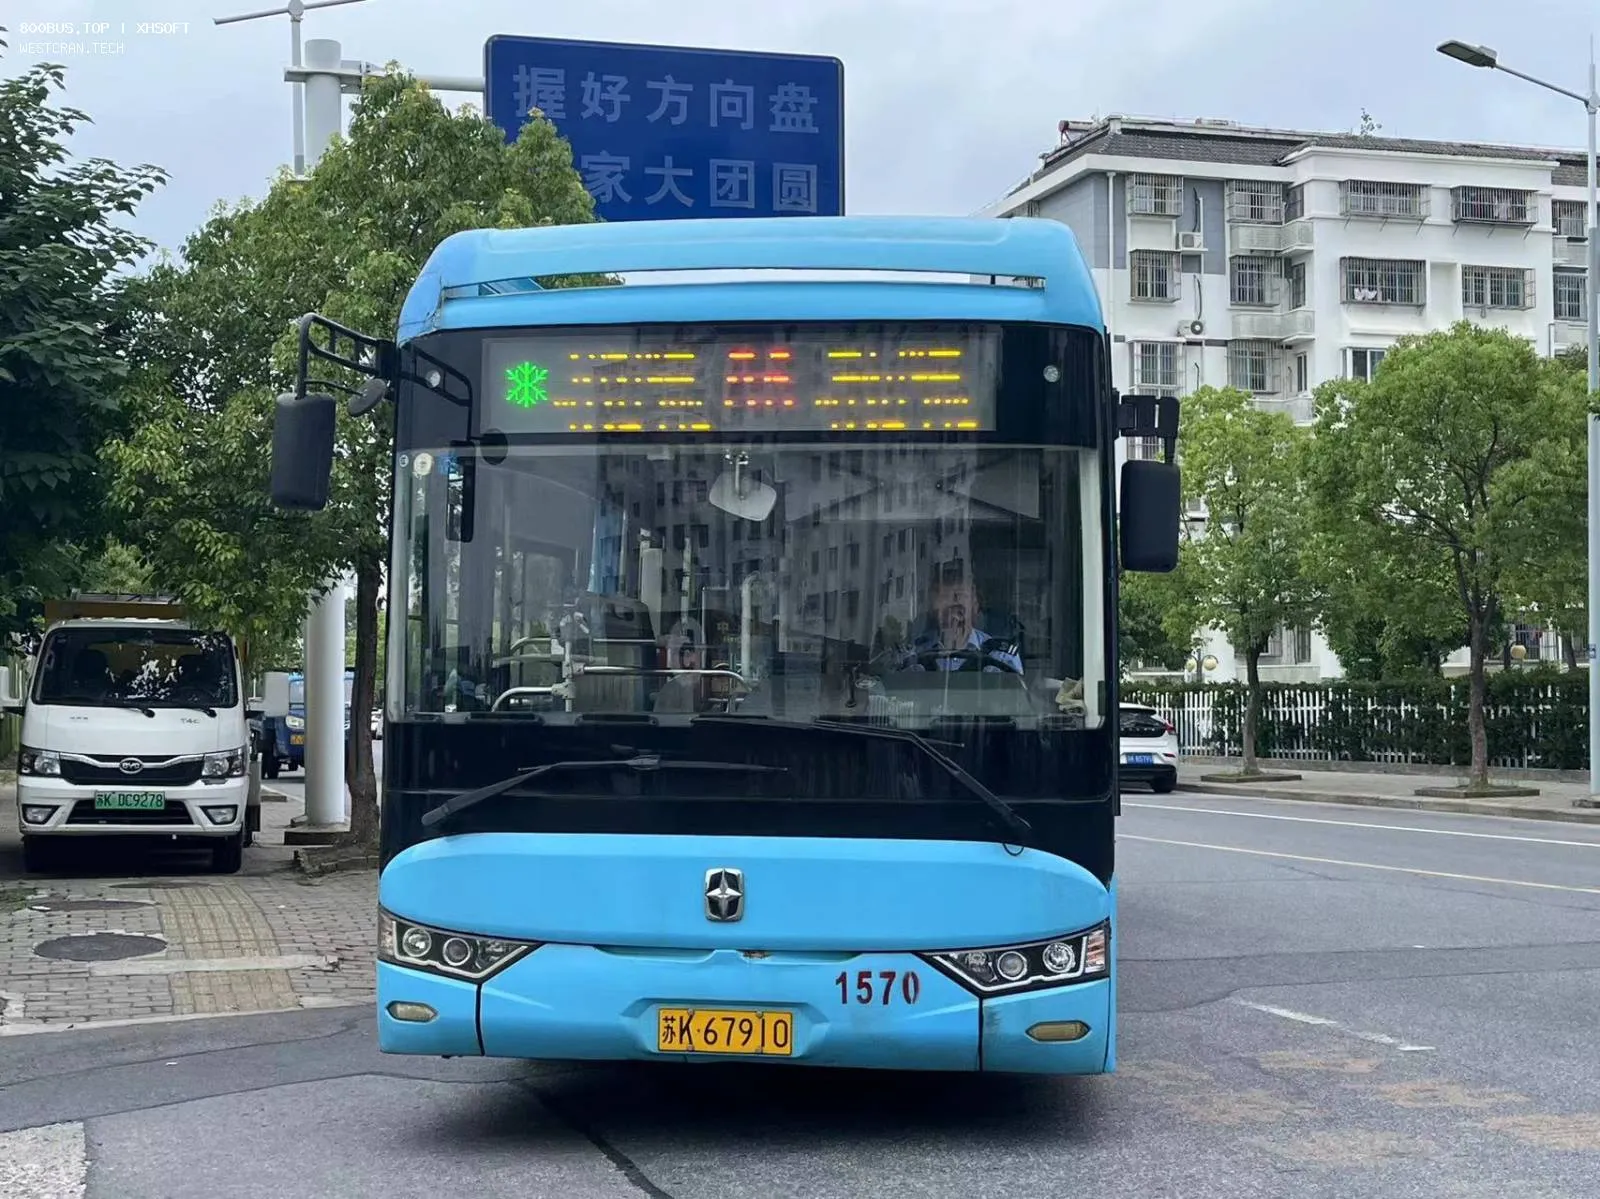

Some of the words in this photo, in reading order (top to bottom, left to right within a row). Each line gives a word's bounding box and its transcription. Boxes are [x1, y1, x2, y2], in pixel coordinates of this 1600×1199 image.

[512, 64, 819, 134] 握好方向盘
[121, 761, 141, 770] BYD
[835, 970, 920, 1005] 1570
